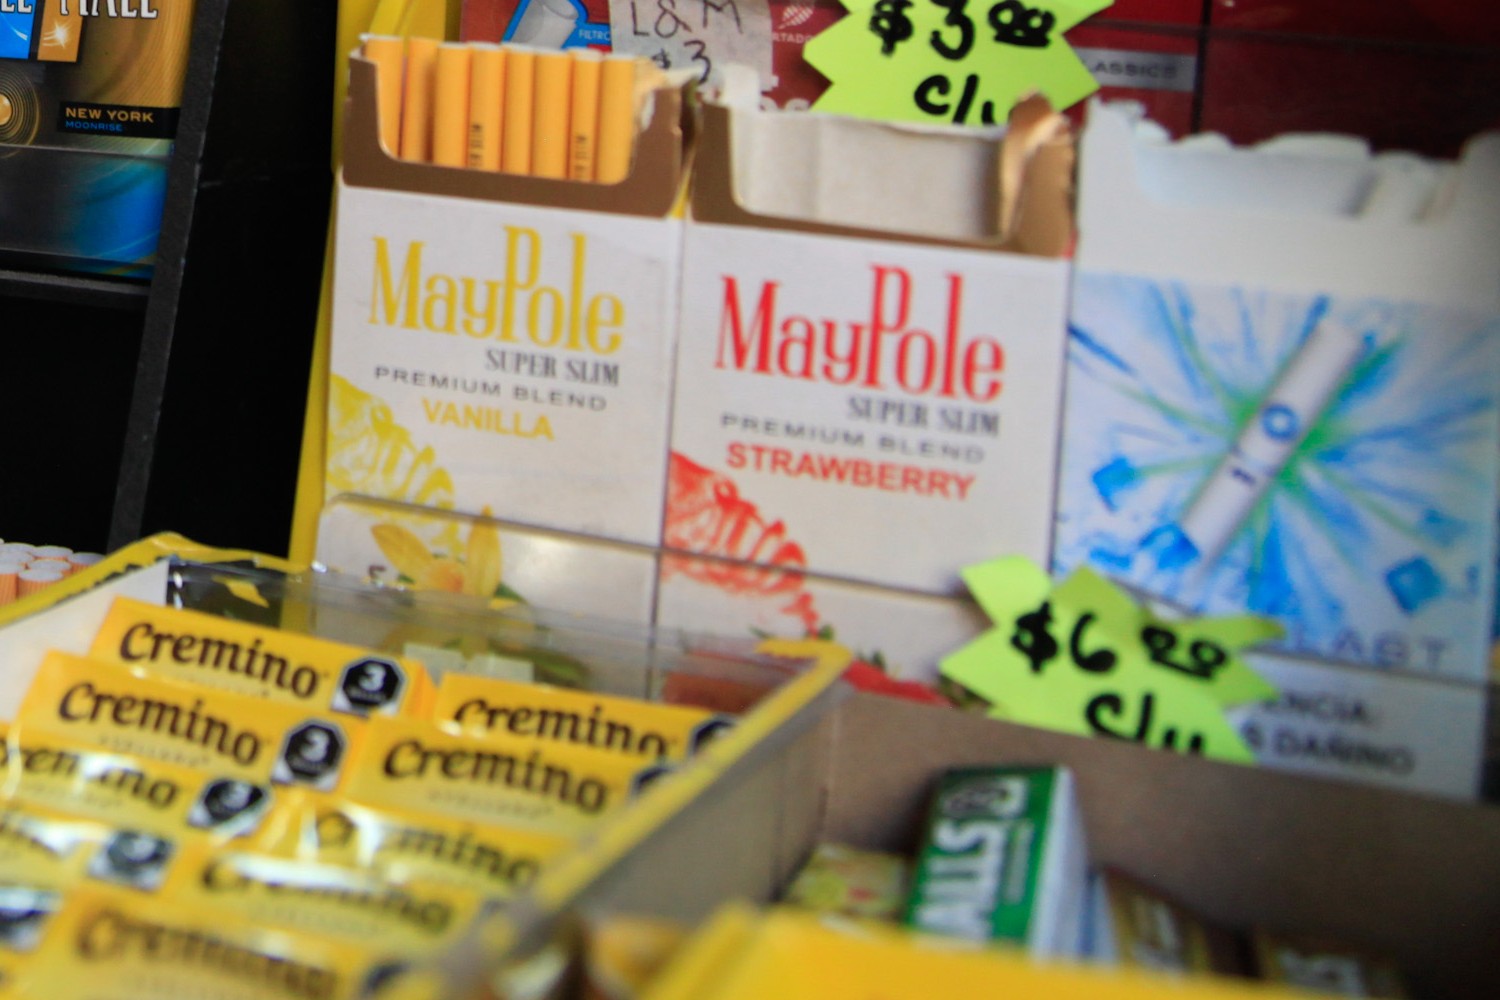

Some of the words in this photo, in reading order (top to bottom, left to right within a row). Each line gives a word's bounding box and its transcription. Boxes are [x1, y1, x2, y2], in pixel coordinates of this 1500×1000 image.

[65, 107, 102, 121] NEW
[108, 110, 154, 124] YORK
[65, 121, 123, 132] MOONRISE
[368, 224, 625, 355] MayPole
[714, 263, 1005, 404] MayPole
[375, 365, 501, 397] PREMIUM
[514, 386, 607, 413] BLEND
[486, 348, 557, 379] SUPER
[565, 359, 620, 387] SLIM
[421, 398, 555, 441] VANILLA
[721, 412, 864, 449] PREMIUM
[878, 433, 985, 465] BLEND
[847, 396, 929, 429] SUPER
[940, 406, 999, 438] SLIM
[726, 441, 976, 502] STRAWBERRY
[119, 622, 320, 699] Cremino
[358, 661, 387, 693] 3
[58, 683, 261, 766] Cremino
[300, 731, 330, 763] 3
[454, 698, 669, 758] Cremino
[383, 739, 609, 815] Cremino
